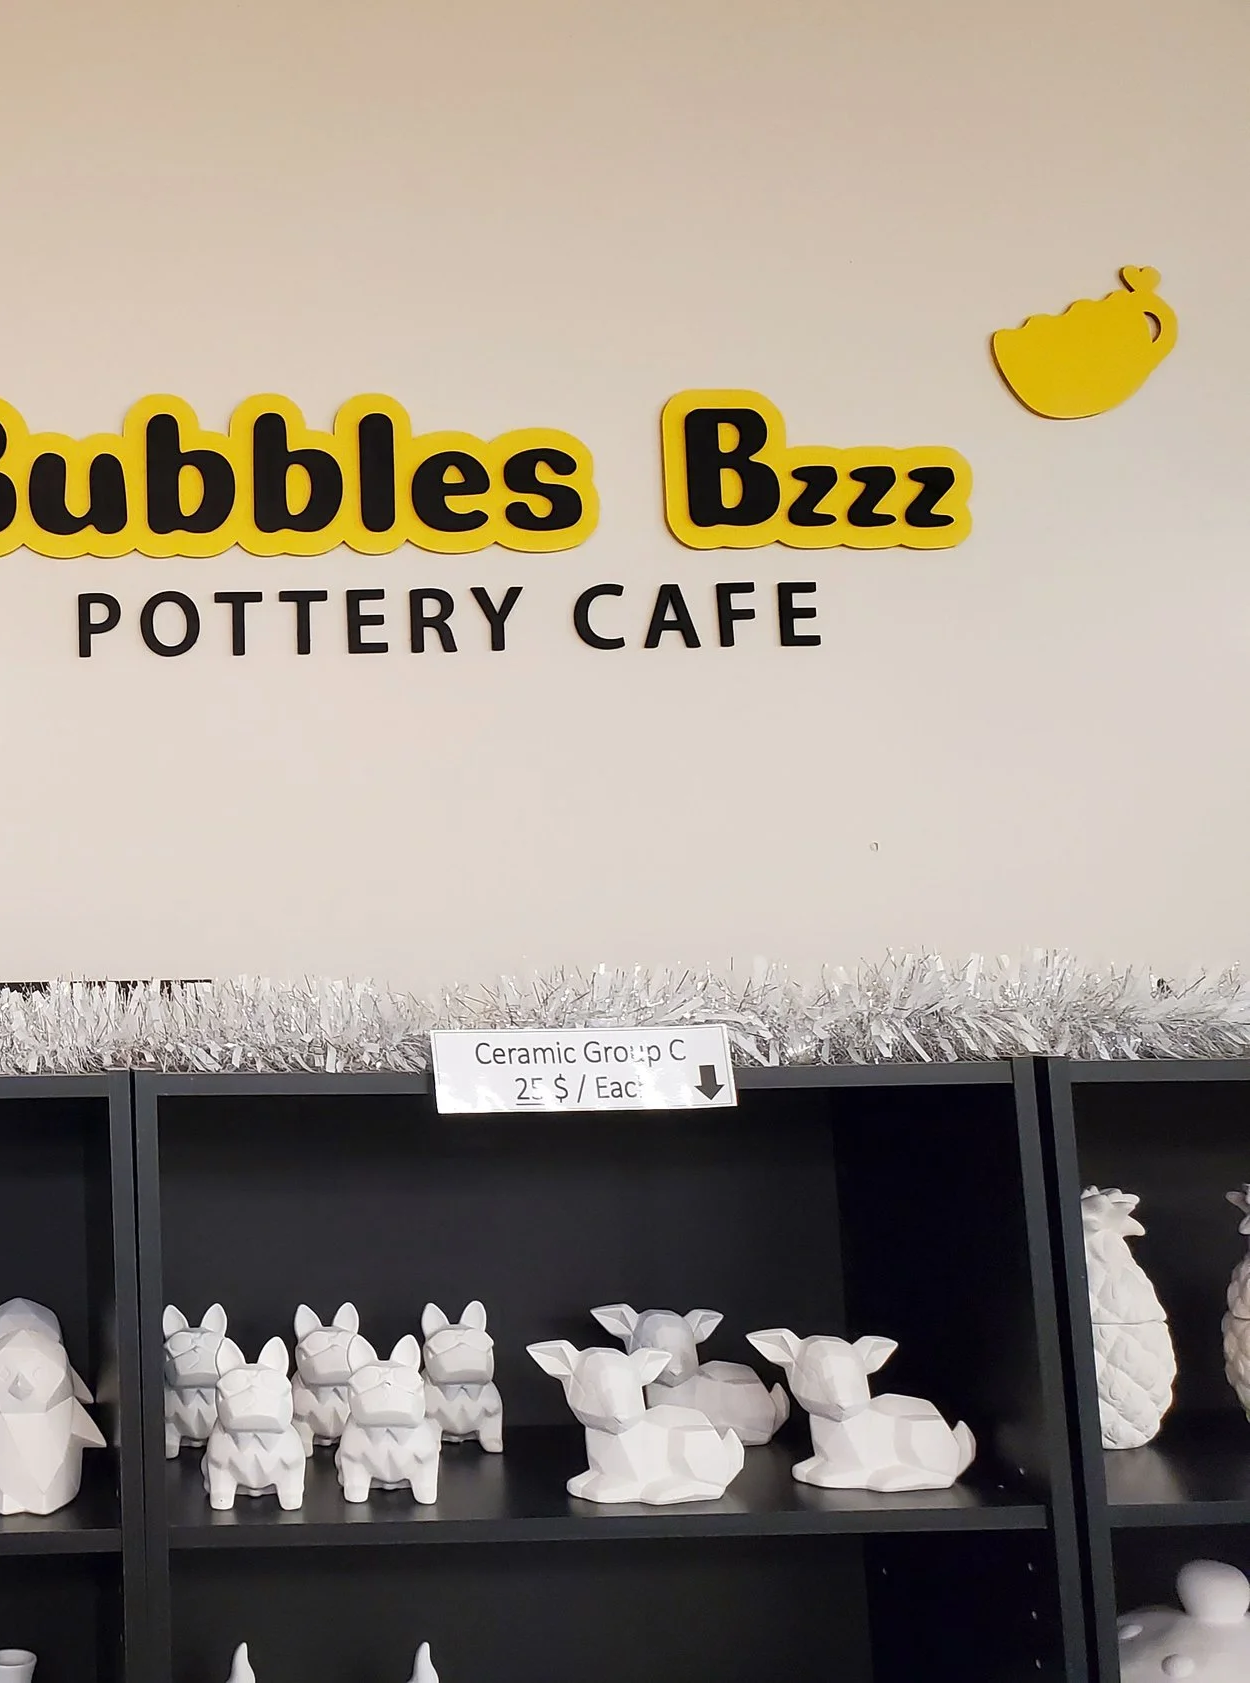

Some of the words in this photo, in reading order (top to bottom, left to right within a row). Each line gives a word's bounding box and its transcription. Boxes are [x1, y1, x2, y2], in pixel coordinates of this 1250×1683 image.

[684, 408, 956, 528] Bzzz
[77, 586, 524, 658] POTTERY
[573, 581, 822, 651] CAFE
[474, 1041, 577, 1065] Ceramic
[669, 1039, 687, 1061] C
[554, 1073, 569, 1103] $
[577, 1074, 586, 1104] /
